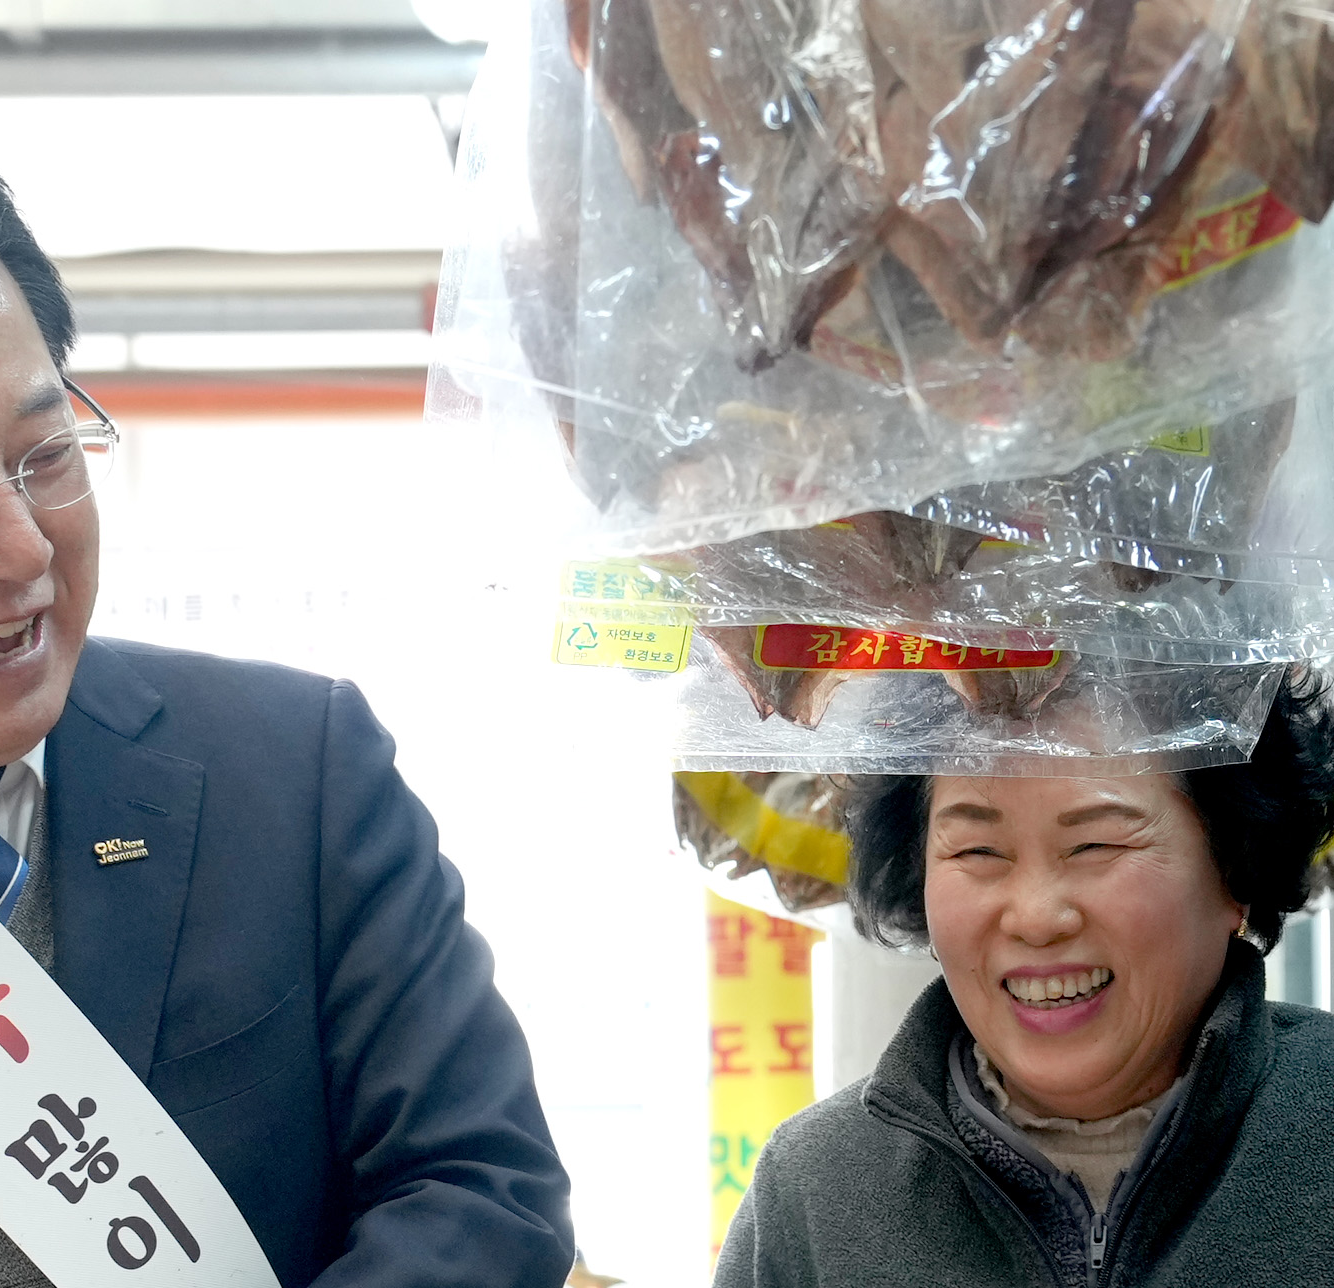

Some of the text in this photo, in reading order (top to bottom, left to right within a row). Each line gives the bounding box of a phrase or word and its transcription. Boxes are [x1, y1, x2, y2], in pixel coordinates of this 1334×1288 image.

[606, 628, 657, 643] 자연보호
[623, 648, 675, 663] 환경보호
[122, 839, 145, 850] Now
[98, 848, 148, 864] Jeonnam
[4, 1093, 201, 1270] 많이
